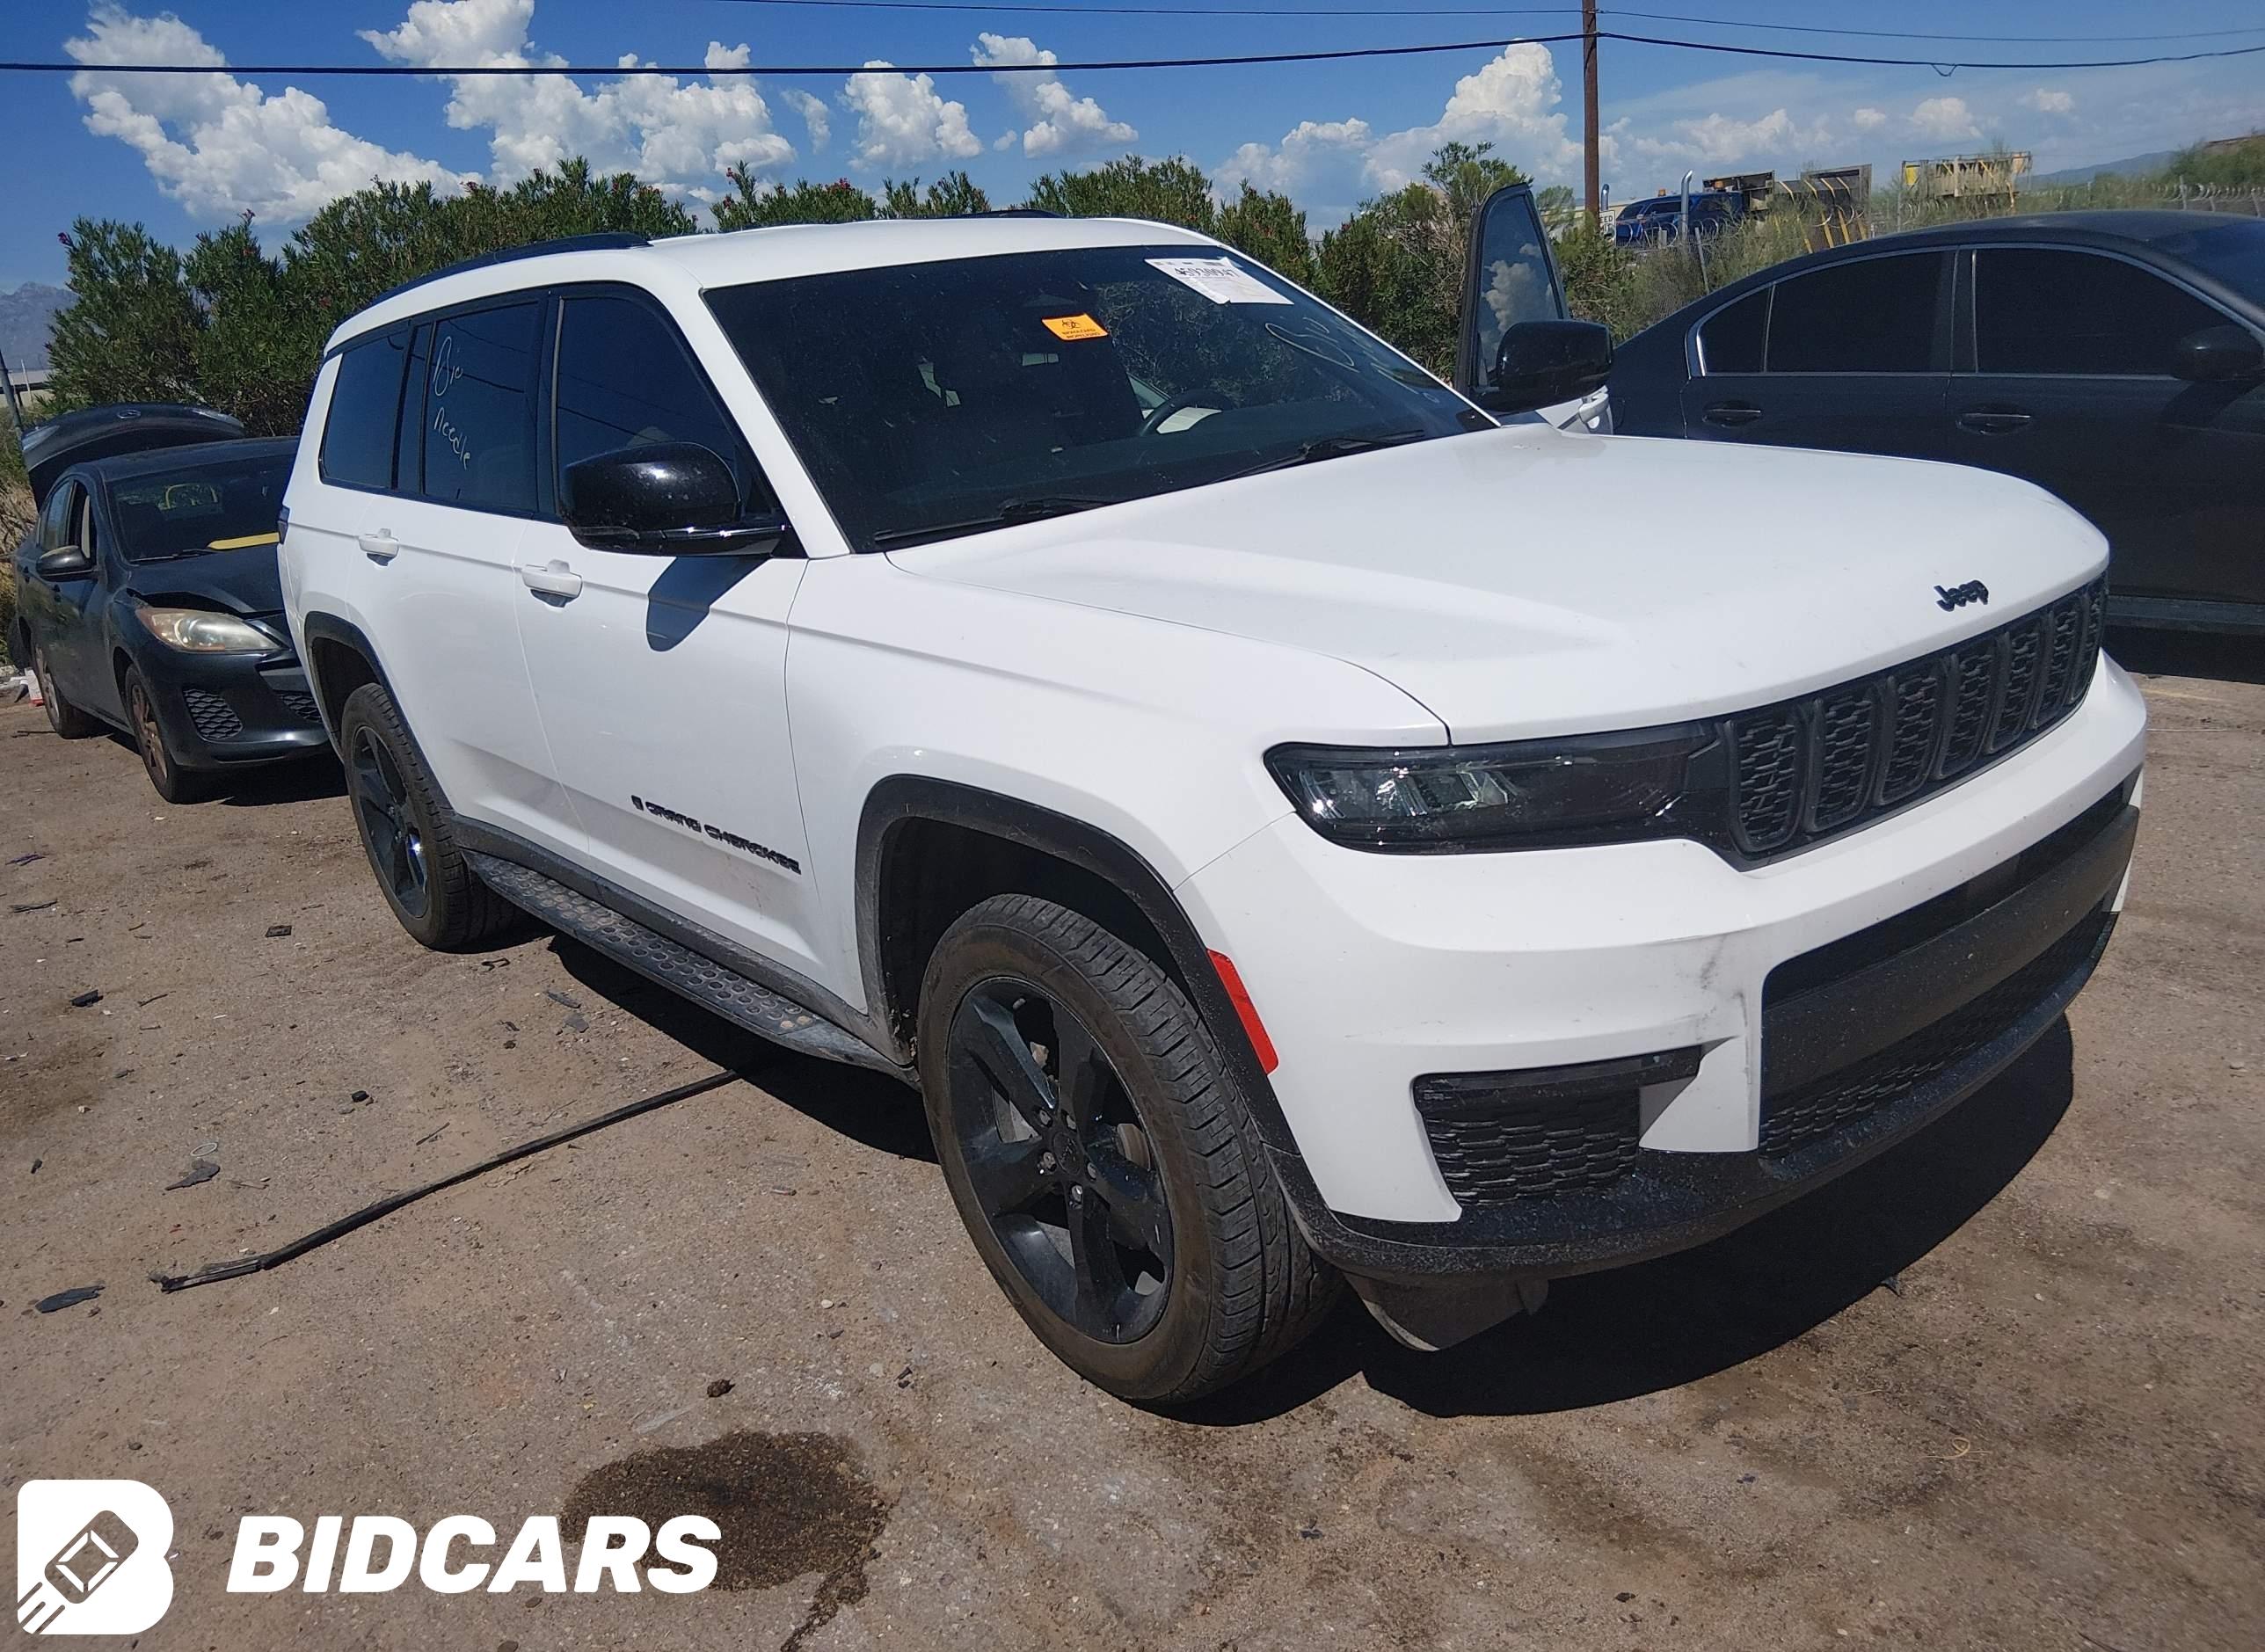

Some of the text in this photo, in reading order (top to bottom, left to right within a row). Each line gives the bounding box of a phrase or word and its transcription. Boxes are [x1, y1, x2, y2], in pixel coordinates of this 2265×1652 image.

[1934, 579, 1989, 612] Jeep
[645, 801, 802, 876] GRAND CHEROKEE
